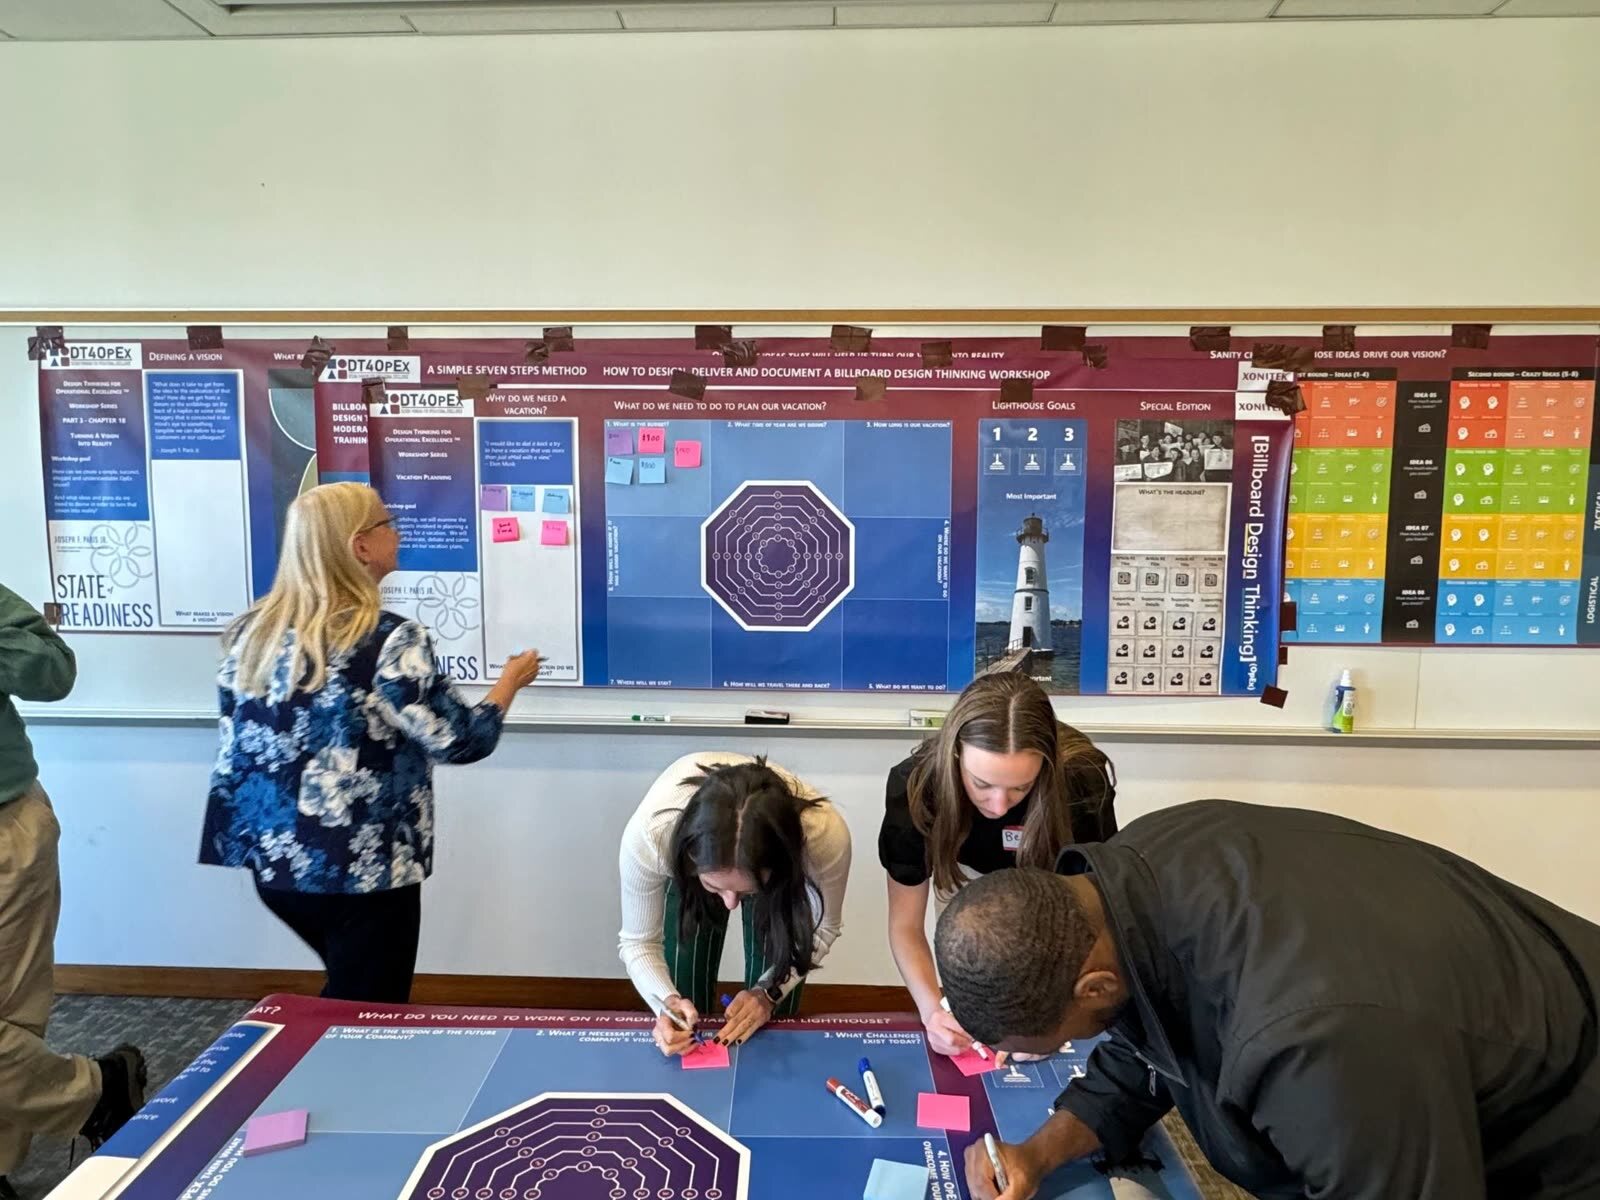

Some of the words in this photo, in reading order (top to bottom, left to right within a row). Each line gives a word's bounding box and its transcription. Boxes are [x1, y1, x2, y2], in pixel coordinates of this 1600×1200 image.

[149, 352, 187, 361] DEFINING
[189, 353, 195, 361] A
[196, 353, 223, 361] VISION
[273, 353, 296, 361] WHAT
[1210, 350, 1241, 359] SANITY
[1335, 351, 1360, 359] IDEAS
[1363, 351, 1388, 359] DRIVE
[1391, 351, 1409, 359] OUR
[1412, 349, 1447, 359] VISION?
[427, 365, 435, 375] A
[437, 366, 473, 376] SIMPLE
[476, 366, 508, 376] SEVEN
[510, 366, 540, 376] STEPS
[542, 366, 588, 376] METHOD
[603, 366, 630, 376] HOW
[632, 366, 646, 376] TO
[692, 367, 733, 377] DELIVER
[736, 367, 759, 377] AND
[761, 368, 822, 378] DOCUMENT
[824, 369, 832, 378] A
[834, 369, 892, 379] BILLBOARD
[894, 370, 933, 379] DESIGN
[935, 370, 987, 380] THINKING
[989, 370, 1051, 380] WORKSHOP
[1242, 372, 1288, 381] XONITEK
[485, 393, 505, 402] WHY
[332, 403, 368, 411] BILLBOA
[504, 405, 548, 415] VACATION?
[614, 401, 640, 410] WHAT
[643, 402, 655, 410] DO
[657, 402, 671, 410] WE
[673, 402, 694, 410] NEED
[696, 402, 707, 410] TO
[710, 402, 722, 410] DO
[724, 402, 736, 410] TO
[738, 402, 759, 410] PLAN
[761, 402, 780, 410] OUR
[781, 401, 827, 411] VACATION?
[992, 401, 1045, 410] LIGHTHOUSE
[1047, 401, 1076, 410] GOALS
[1140, 401, 1174, 410] SPECIAL
[1177, 401, 1212, 410] EDITION
[332, 414, 361, 422] DESIGN
[993, 427, 1001, 441] 1
[1027, 427, 1038, 441] 2
[1064, 427, 1075, 441] 3
[334, 436, 369, 444] TRAININ
[1024, 493, 1057, 501] Important
[1242, 522, 1264, 579] Design
[57, 574, 107, 599] STATE
[1586, 576, 1599, 624] LOGISTICAL
[61, 602, 154, 628] READINESS
[937, 1150, 948, 1159] 4.
[923, 1141, 938, 1180] OVERCOME
[939, 1160, 952, 1181] HOW
